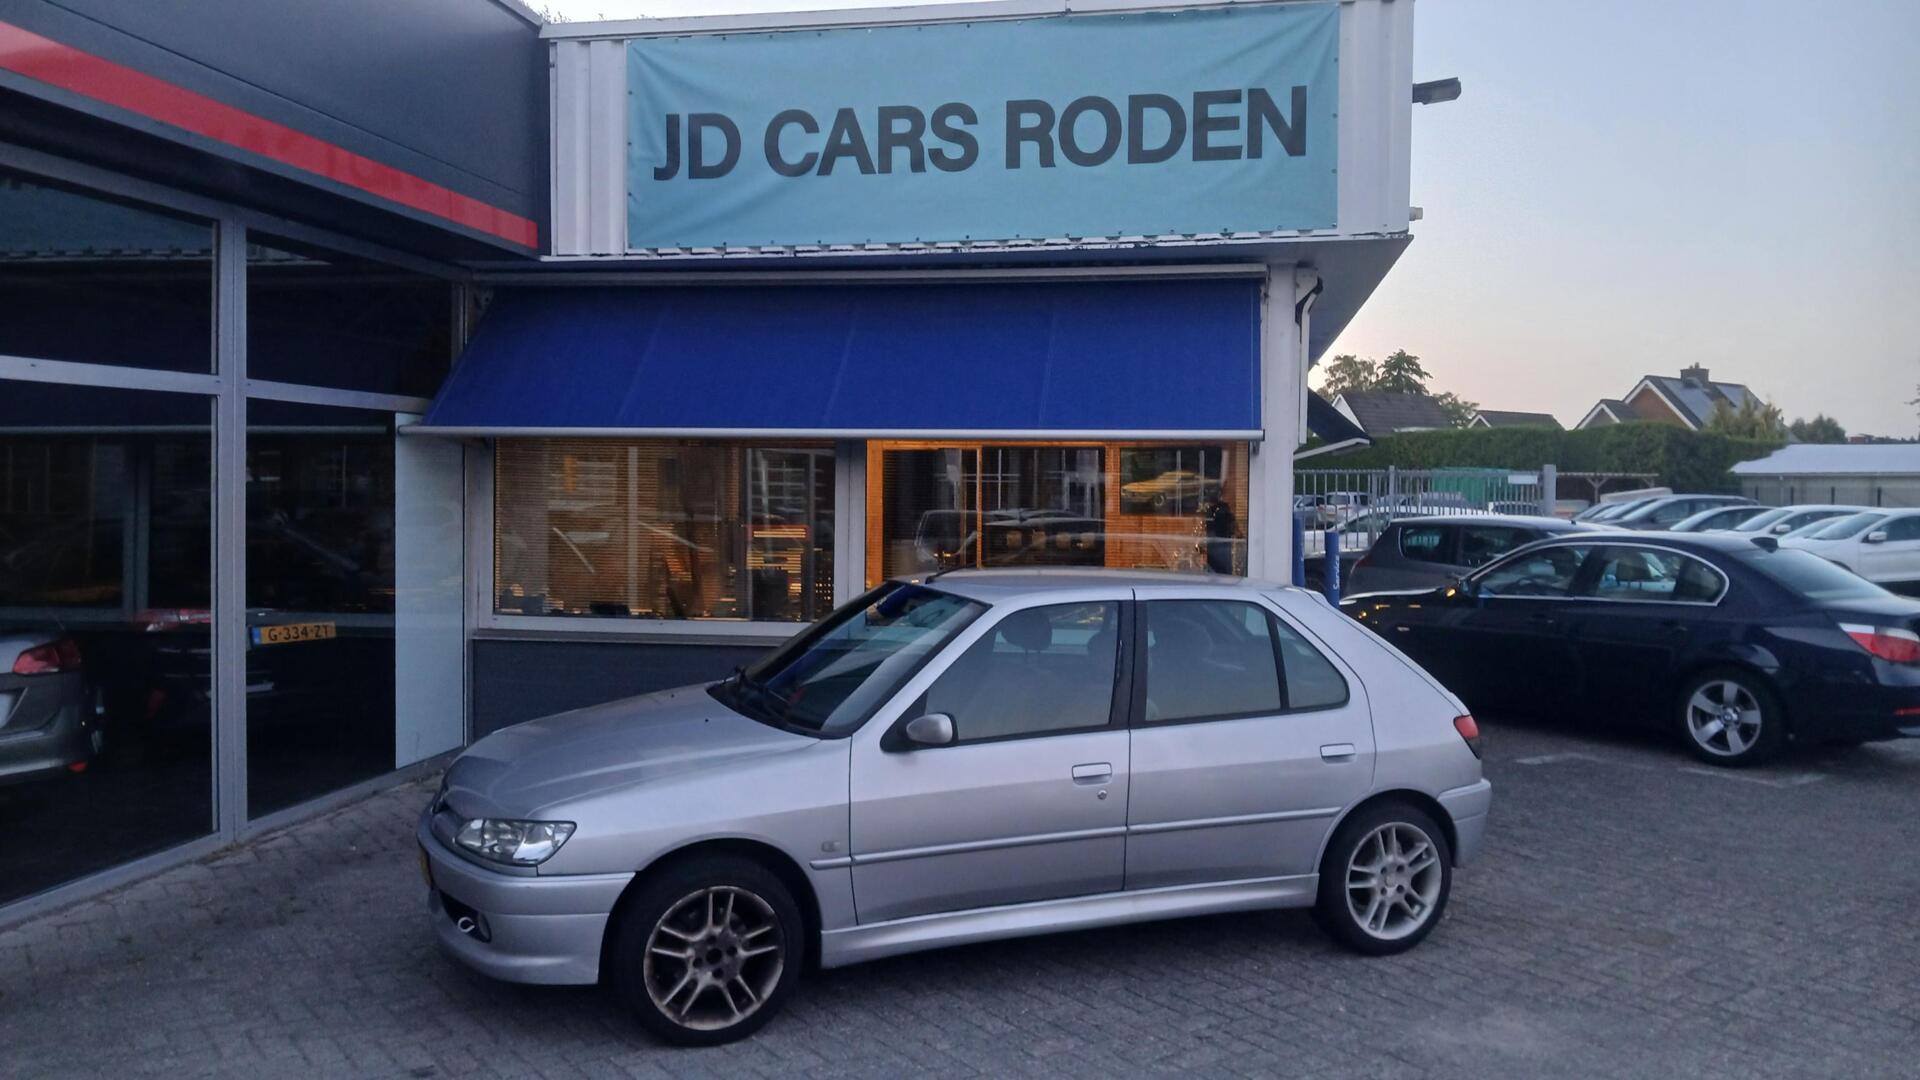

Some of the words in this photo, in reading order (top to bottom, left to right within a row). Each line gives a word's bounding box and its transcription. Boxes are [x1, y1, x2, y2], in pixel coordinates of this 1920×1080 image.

[653, 112, 742, 182] JD
[763, 102, 979, 180] CARS
[1005, 85, 1307, 169] RODEN
[268, 625, 329, 642] G-334-ZT
